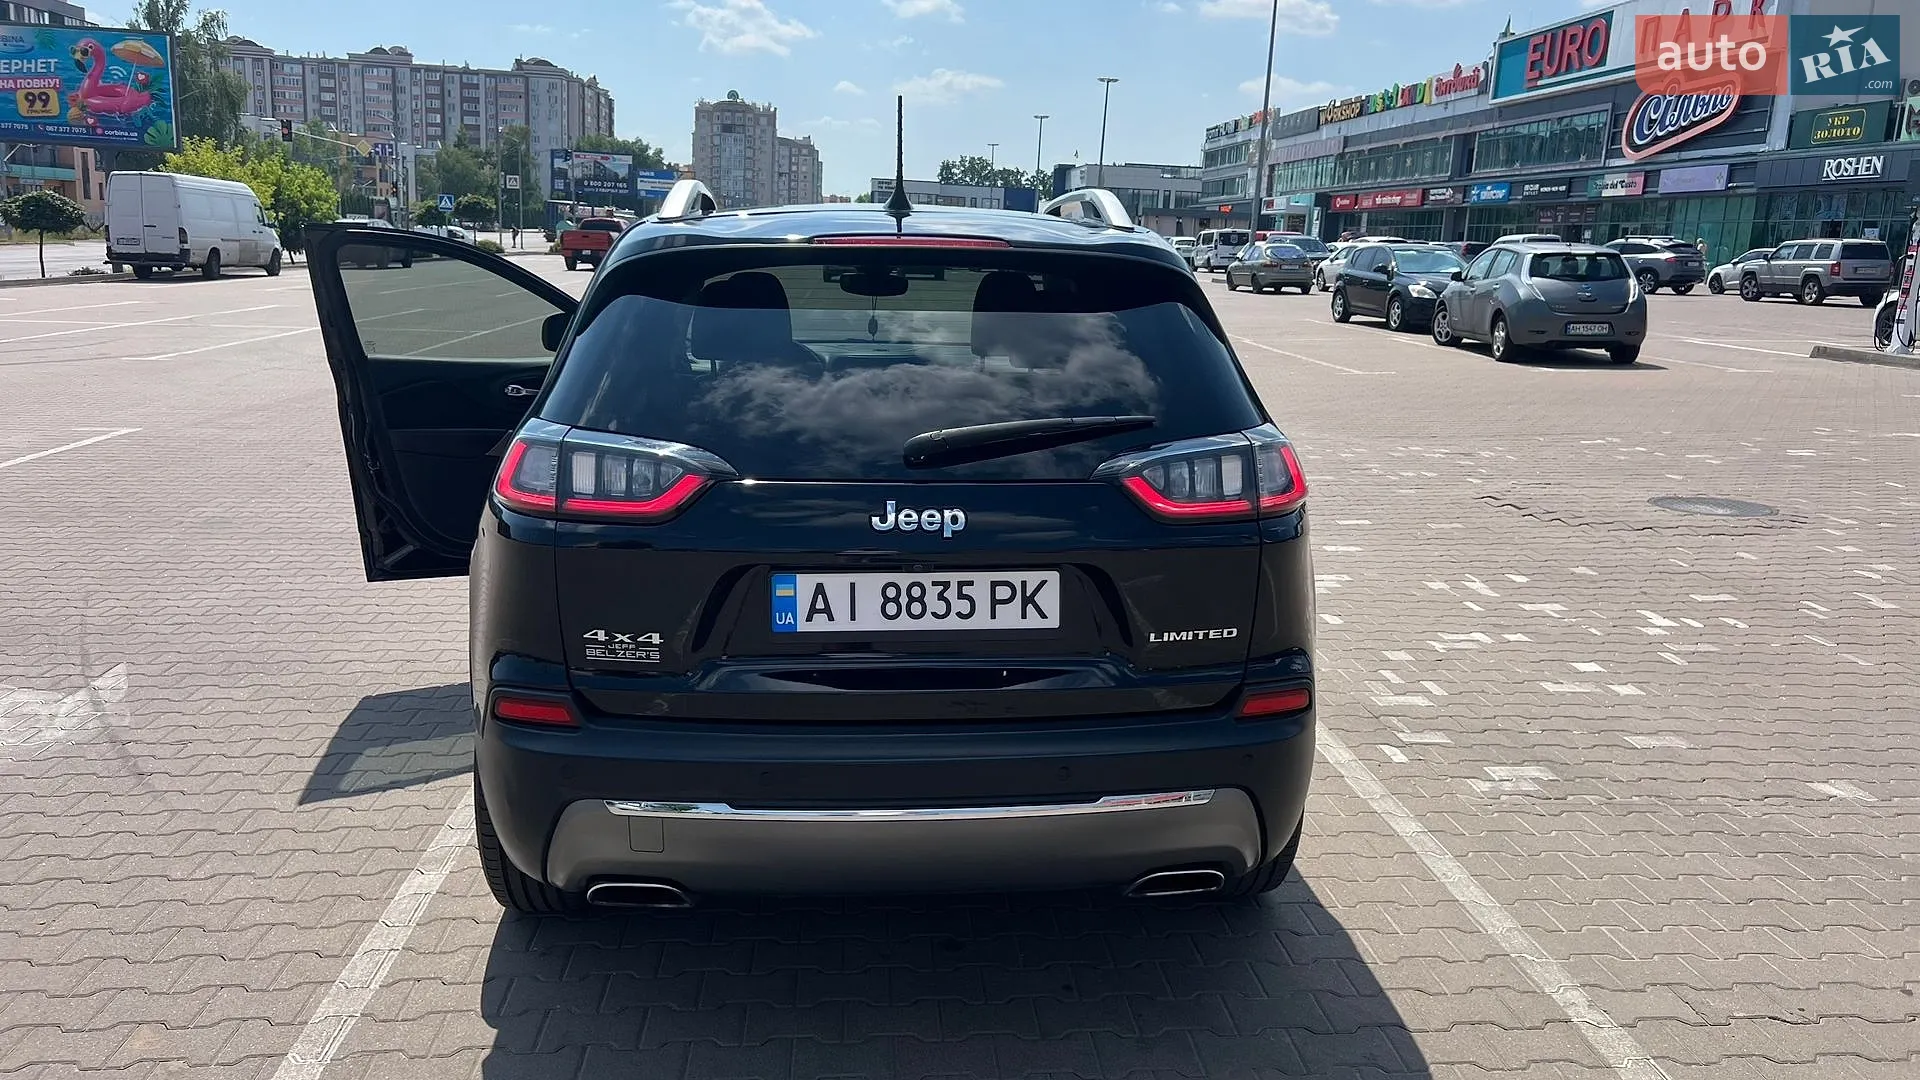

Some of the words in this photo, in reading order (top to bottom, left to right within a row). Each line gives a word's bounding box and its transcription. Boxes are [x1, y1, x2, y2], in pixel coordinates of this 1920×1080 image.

[1525, 17, 1611, 88] EURO
[17, 78, 60, 88] ПОВНУ!
[24, 91, 50, 108] 99
[1827, 115, 1850, 126] УКР
[104, 129, 138, 137] corbina.ua
[1813, 126, 1861, 139] ЗОЛОТО
[1822, 155, 1884, 180] ROSHEN
[871, 500, 966, 537] Jeep
[775, 613, 794, 625] UA
[880, 580, 977, 621] 8835
[989, 579, 1049, 620] PK
[1149, 627, 1238, 642] LIMITED
[585, 648, 660, 659] BELZER'S
